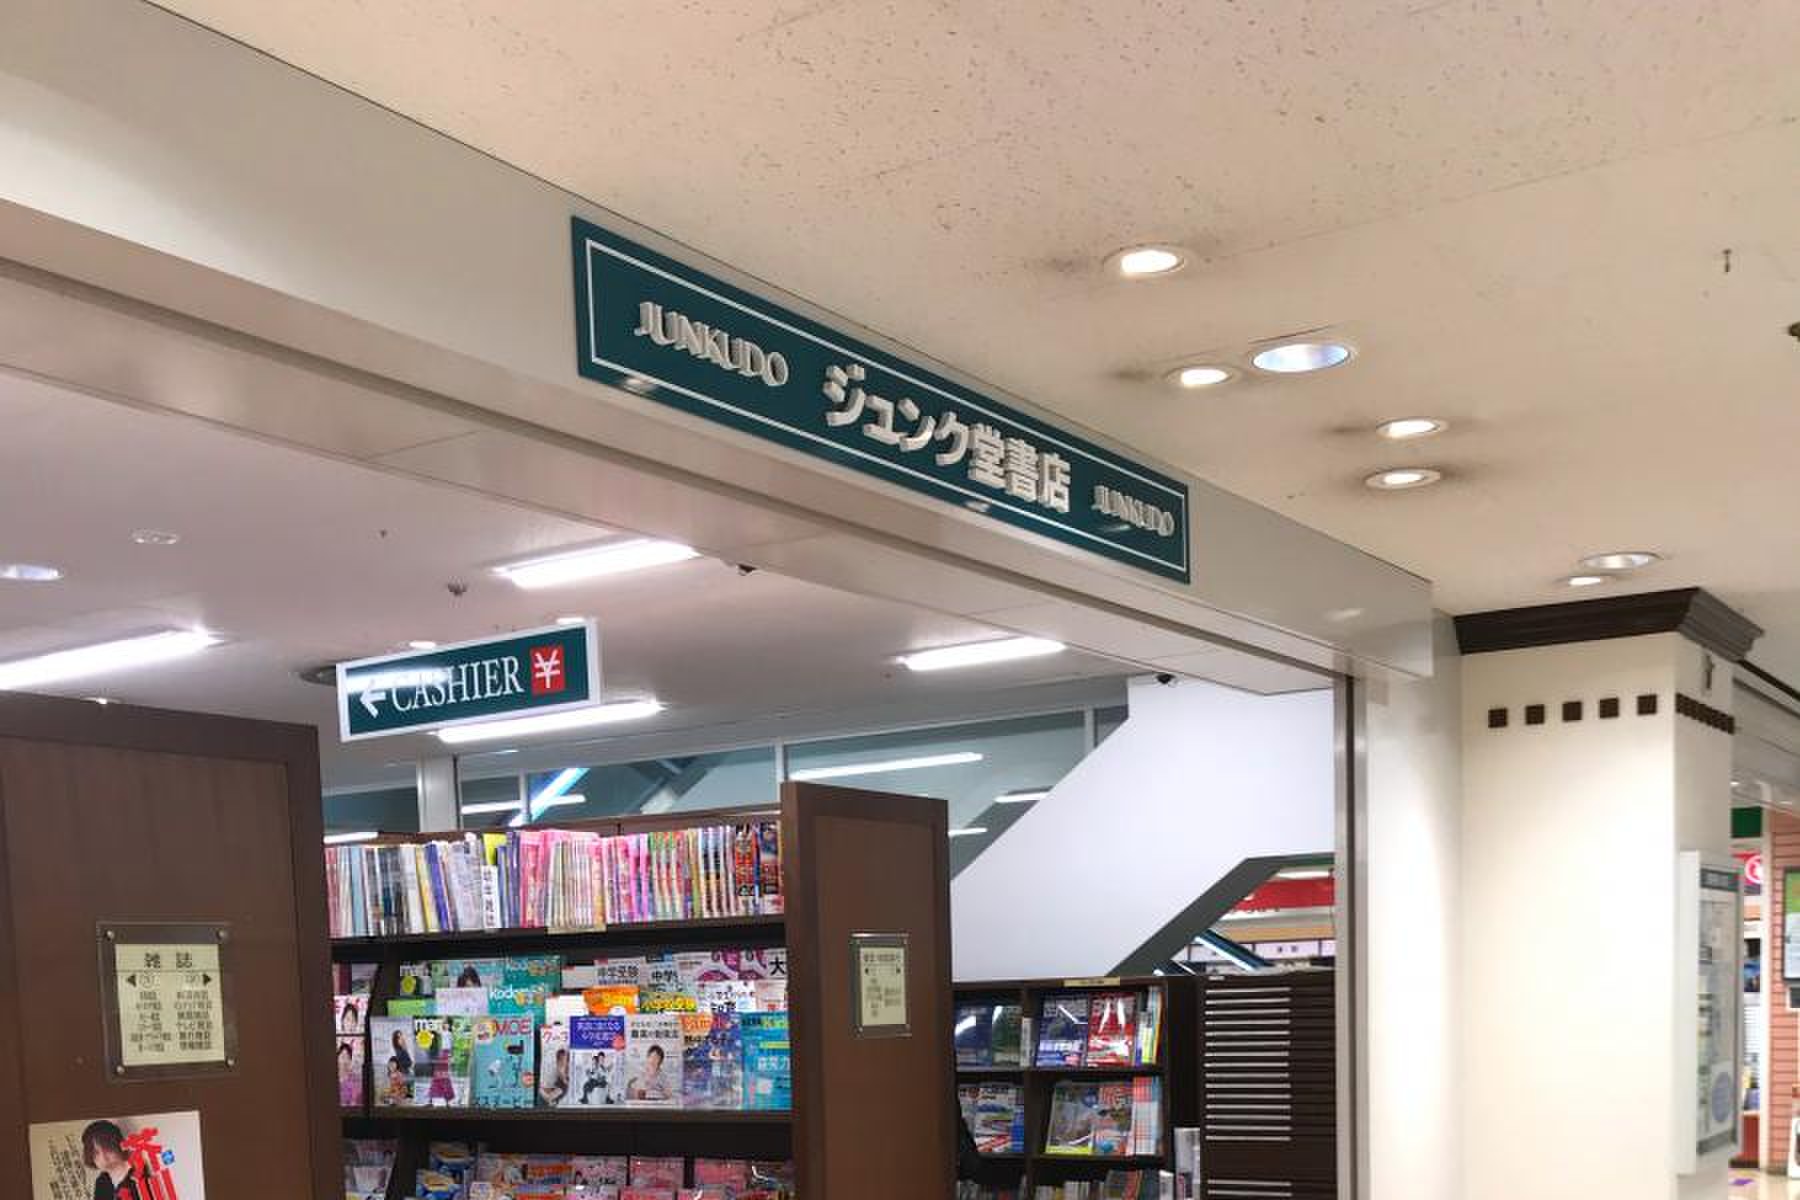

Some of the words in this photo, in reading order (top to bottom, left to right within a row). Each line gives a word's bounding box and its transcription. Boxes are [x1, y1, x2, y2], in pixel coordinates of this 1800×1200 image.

[634, 300, 790, 388] JUNKUDO
[822, 362, 1073, 513] ジュンク堂書店
[1092, 482, 1176, 539] JUNKUDO
[391, 654, 525, 713] CASHIER
